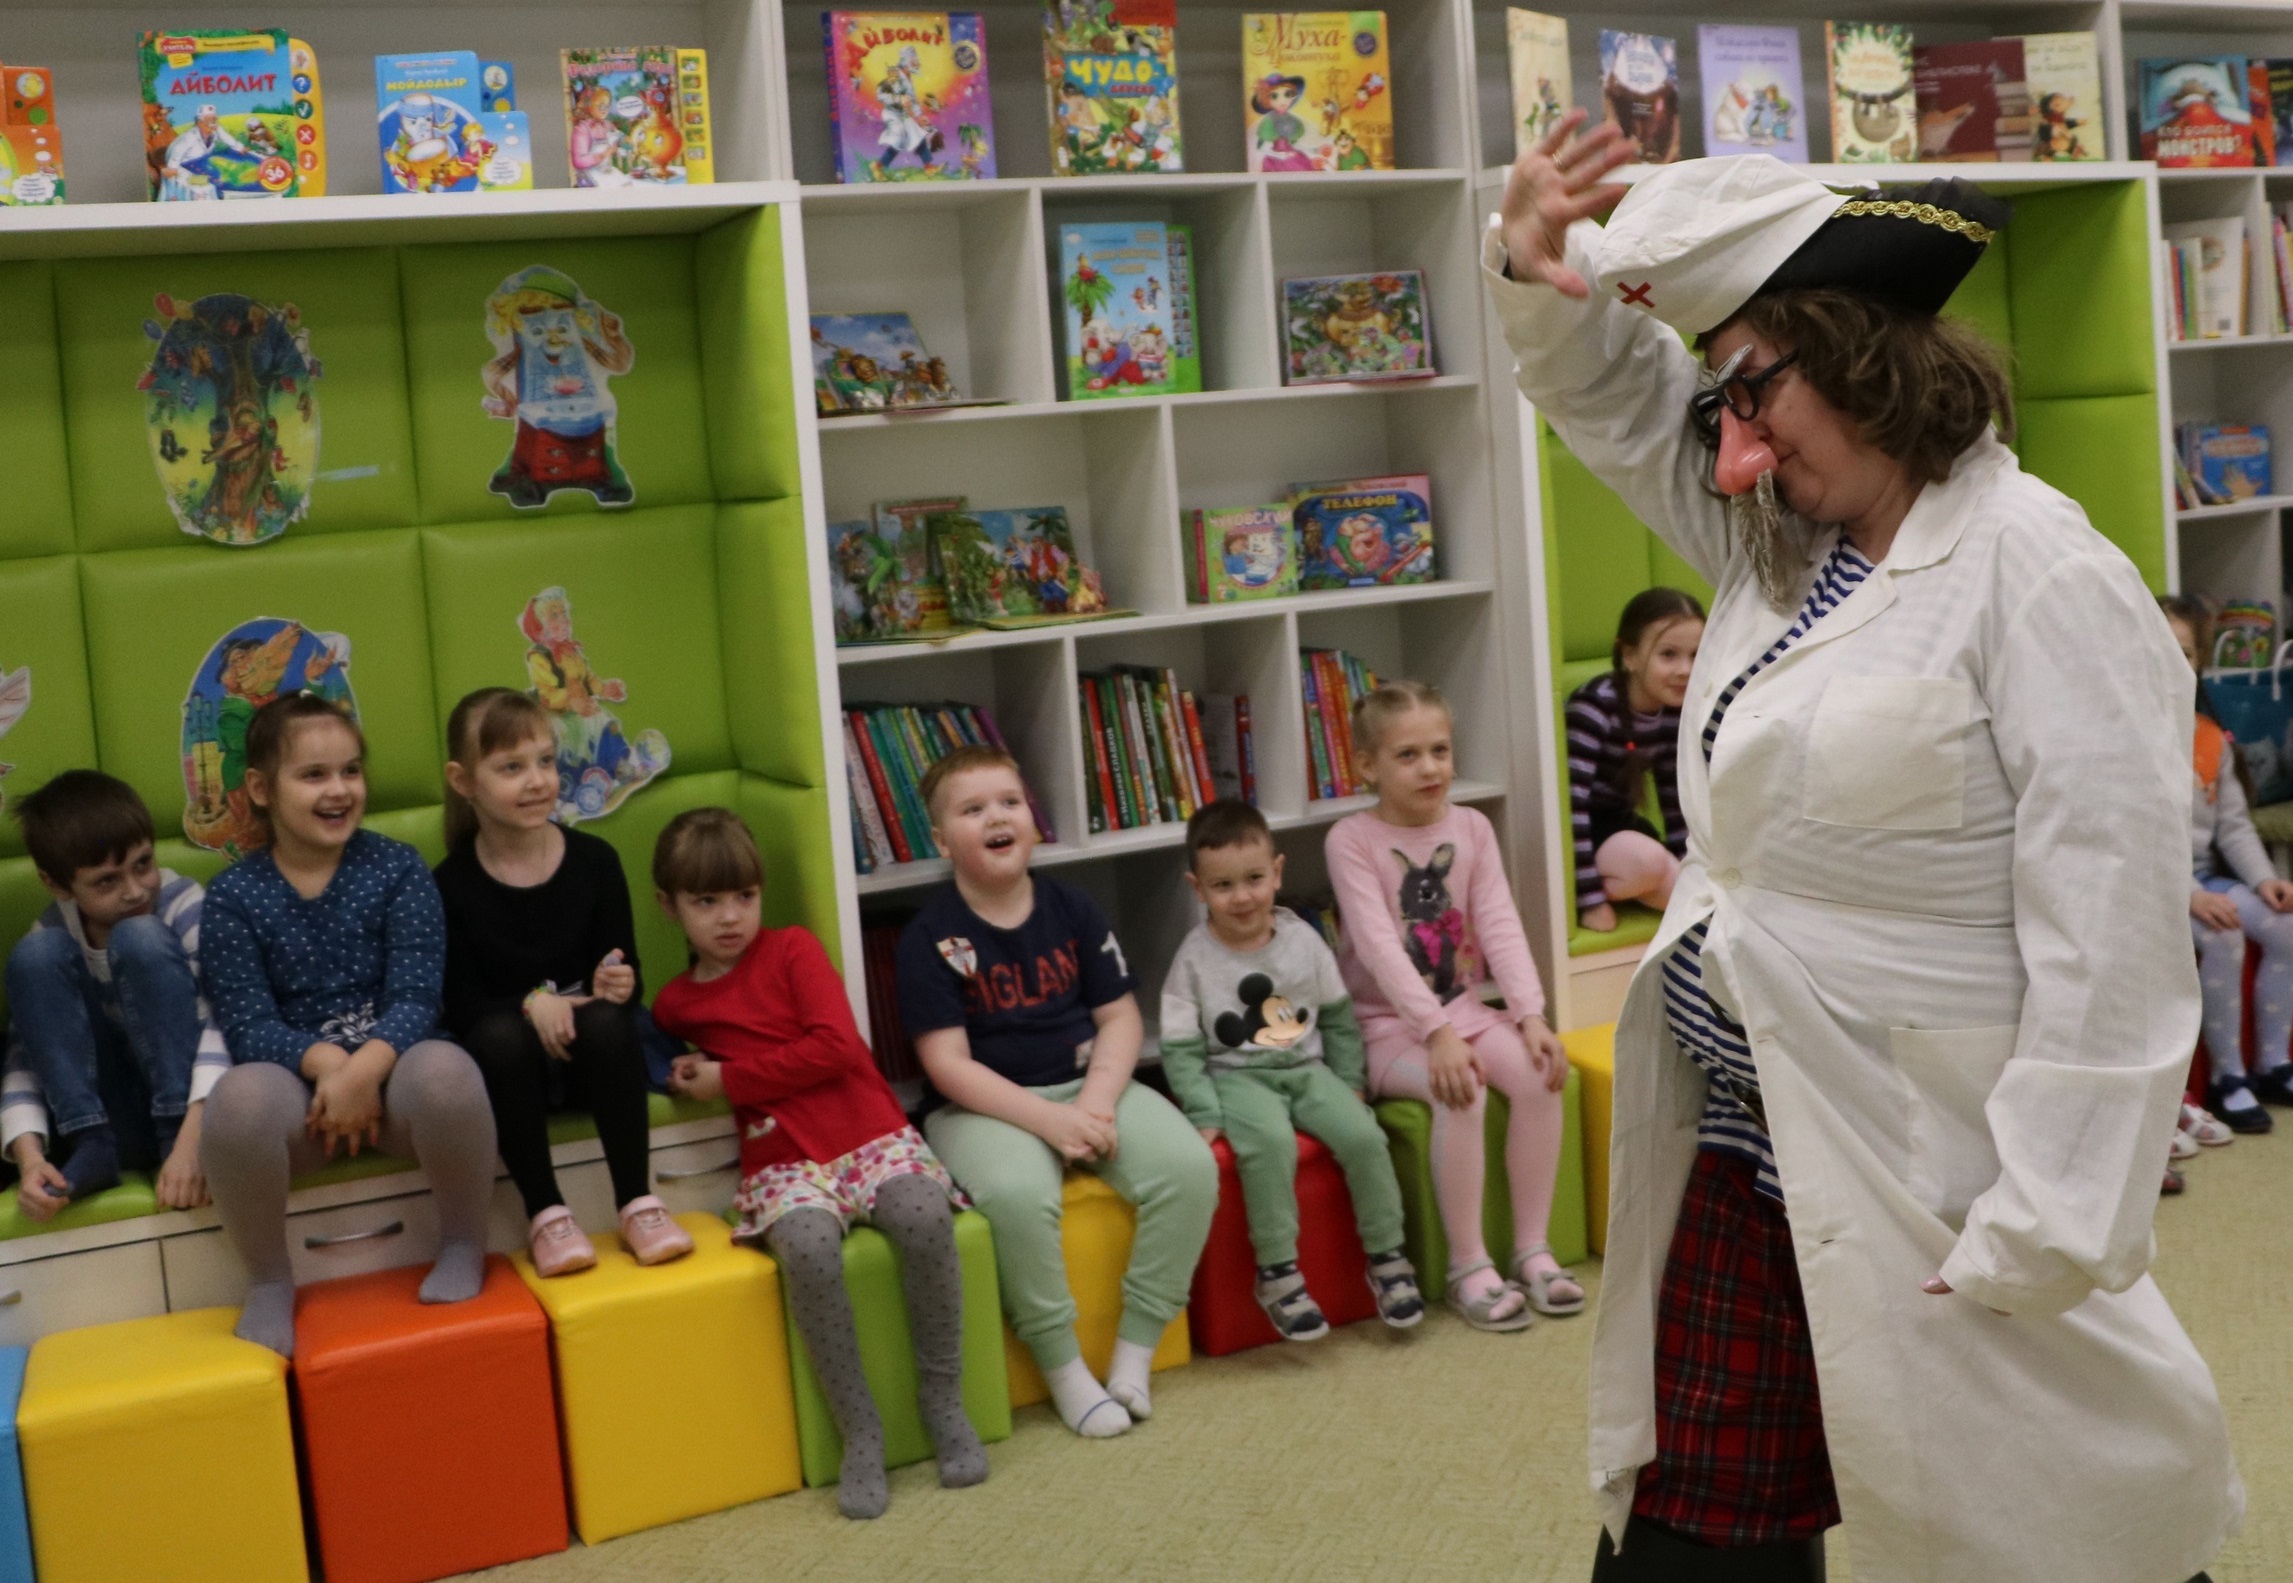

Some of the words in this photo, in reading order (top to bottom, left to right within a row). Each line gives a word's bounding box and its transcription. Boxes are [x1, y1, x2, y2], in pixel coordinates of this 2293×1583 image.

[170, 71, 277, 95] АЙБОЛИТ
[1069, 57, 1160, 85] ЧУДО-
[1321, 494, 1398, 510] ТЕЛЕФОН
